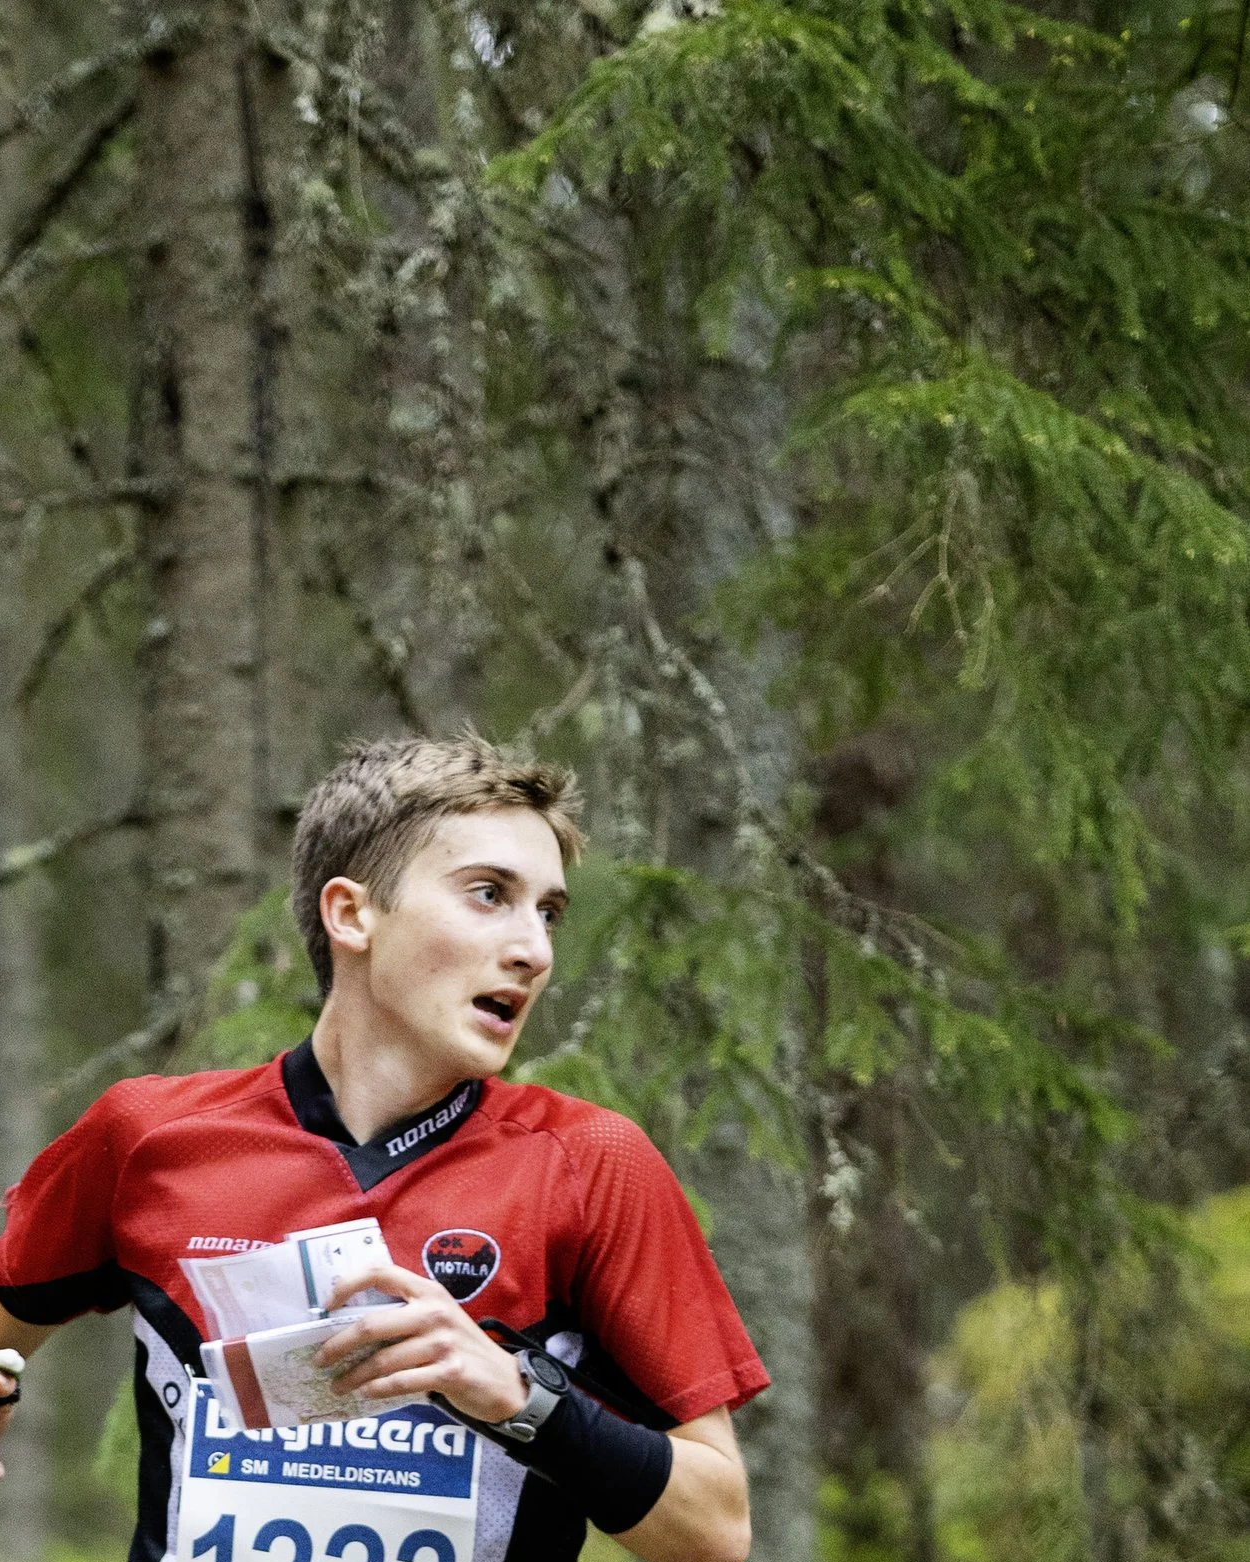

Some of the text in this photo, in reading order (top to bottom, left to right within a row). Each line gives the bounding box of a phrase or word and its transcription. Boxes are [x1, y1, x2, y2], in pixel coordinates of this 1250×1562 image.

[385, 1085, 470, 1157] nonam
[434, 1261, 489, 1276] MOTALA
[241, 1459, 421, 1487] SM MEDELDISTANS
